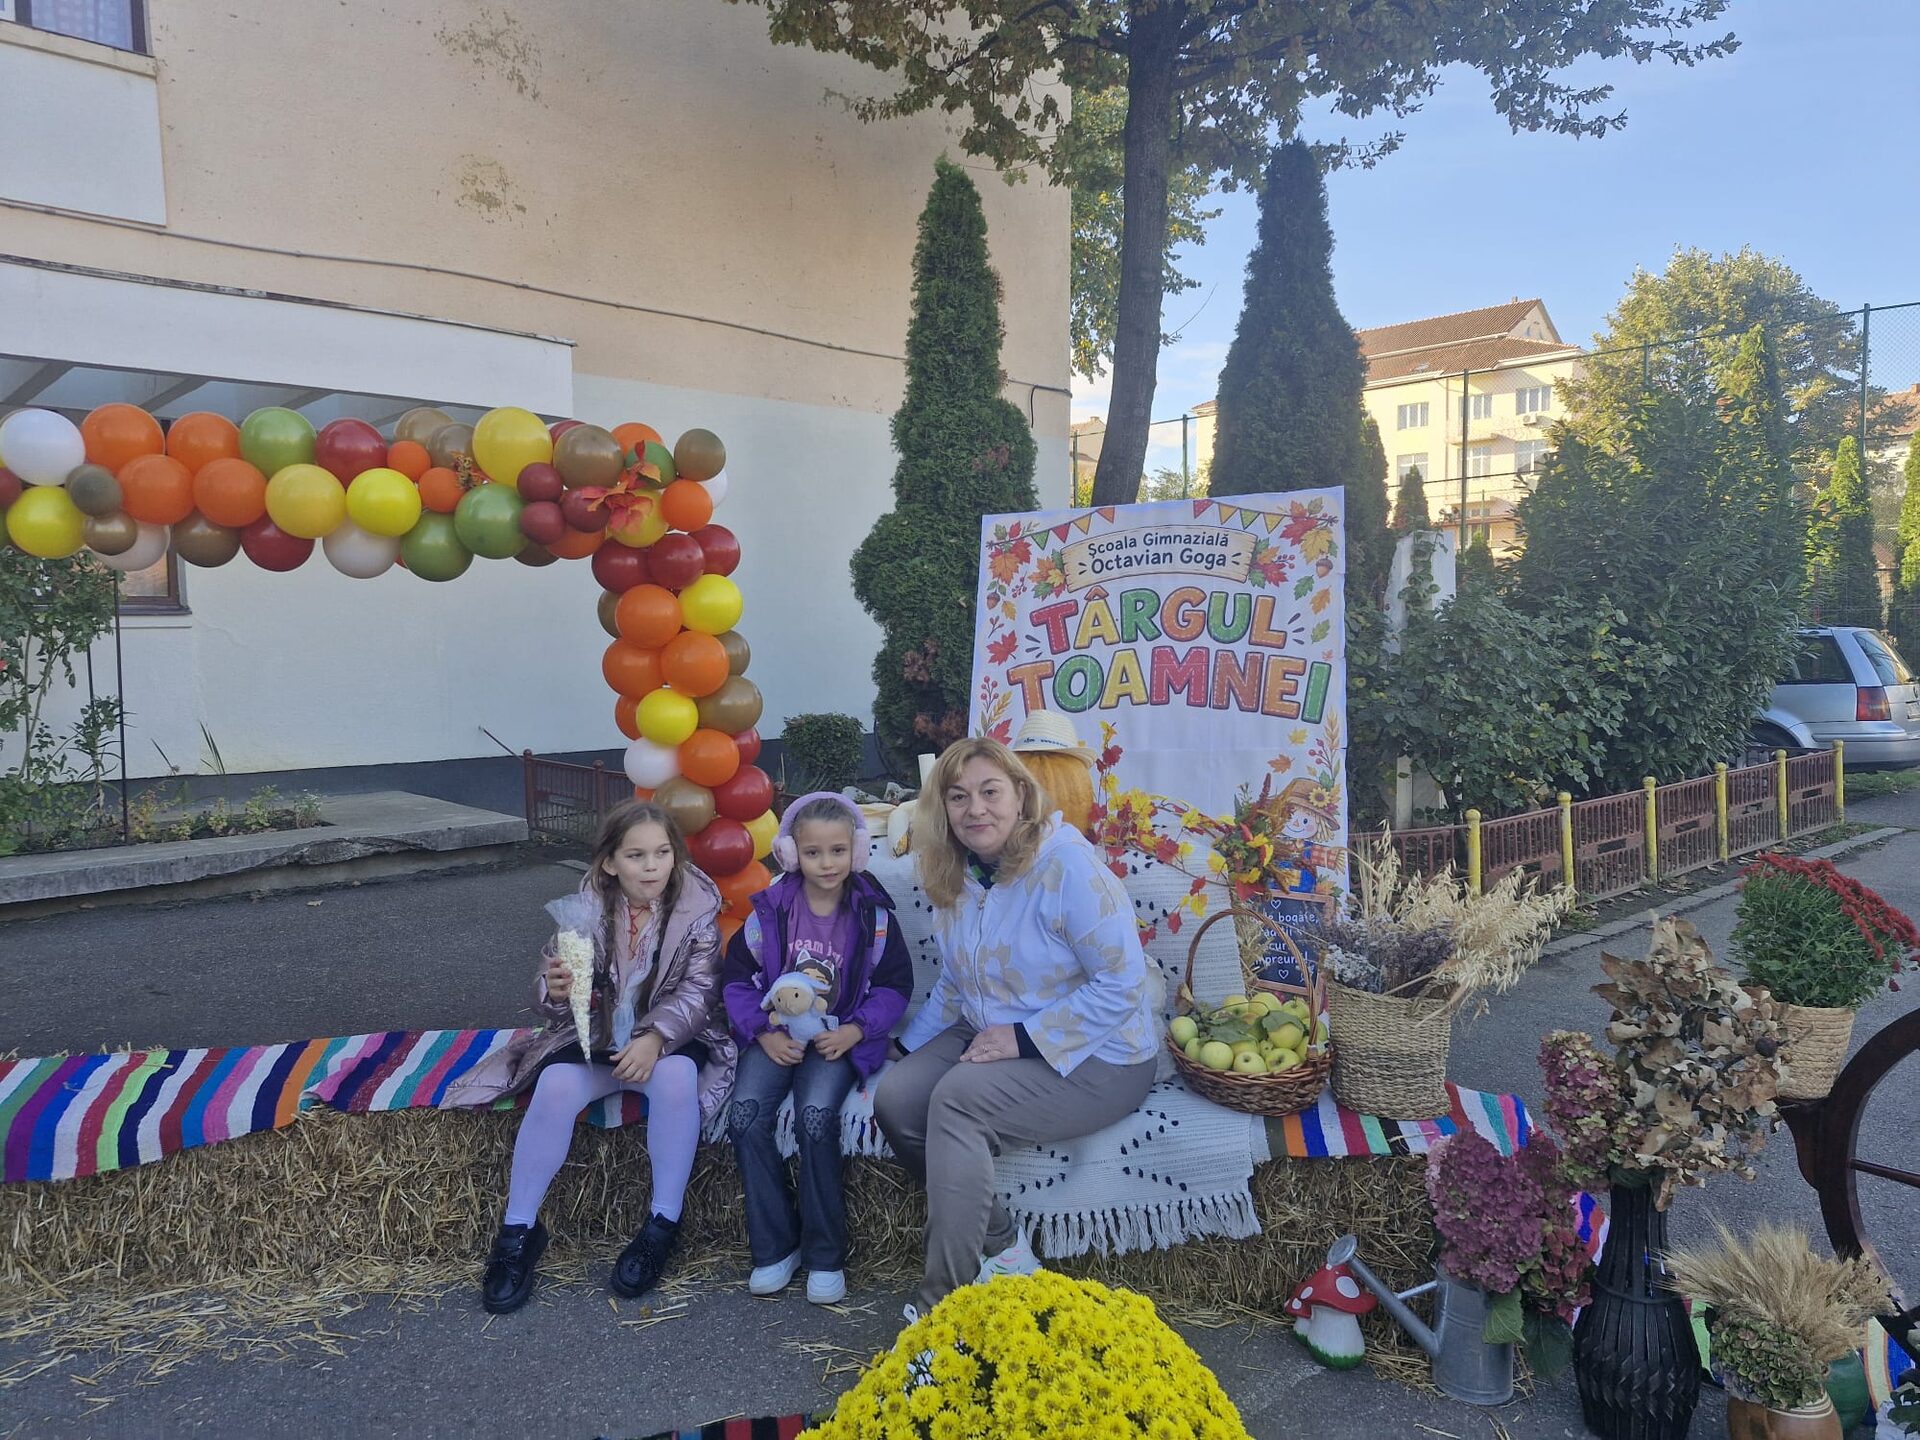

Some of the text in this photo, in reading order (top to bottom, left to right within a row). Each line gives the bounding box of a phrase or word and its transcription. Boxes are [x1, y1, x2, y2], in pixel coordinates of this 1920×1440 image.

[1091, 548, 1227, 574] Octavian Goga
[1143, 532, 1229, 547] Gimnazială
[1029, 586, 1287, 655] TÂRGUL
[1006, 645, 1332, 725] TOAMNEI
